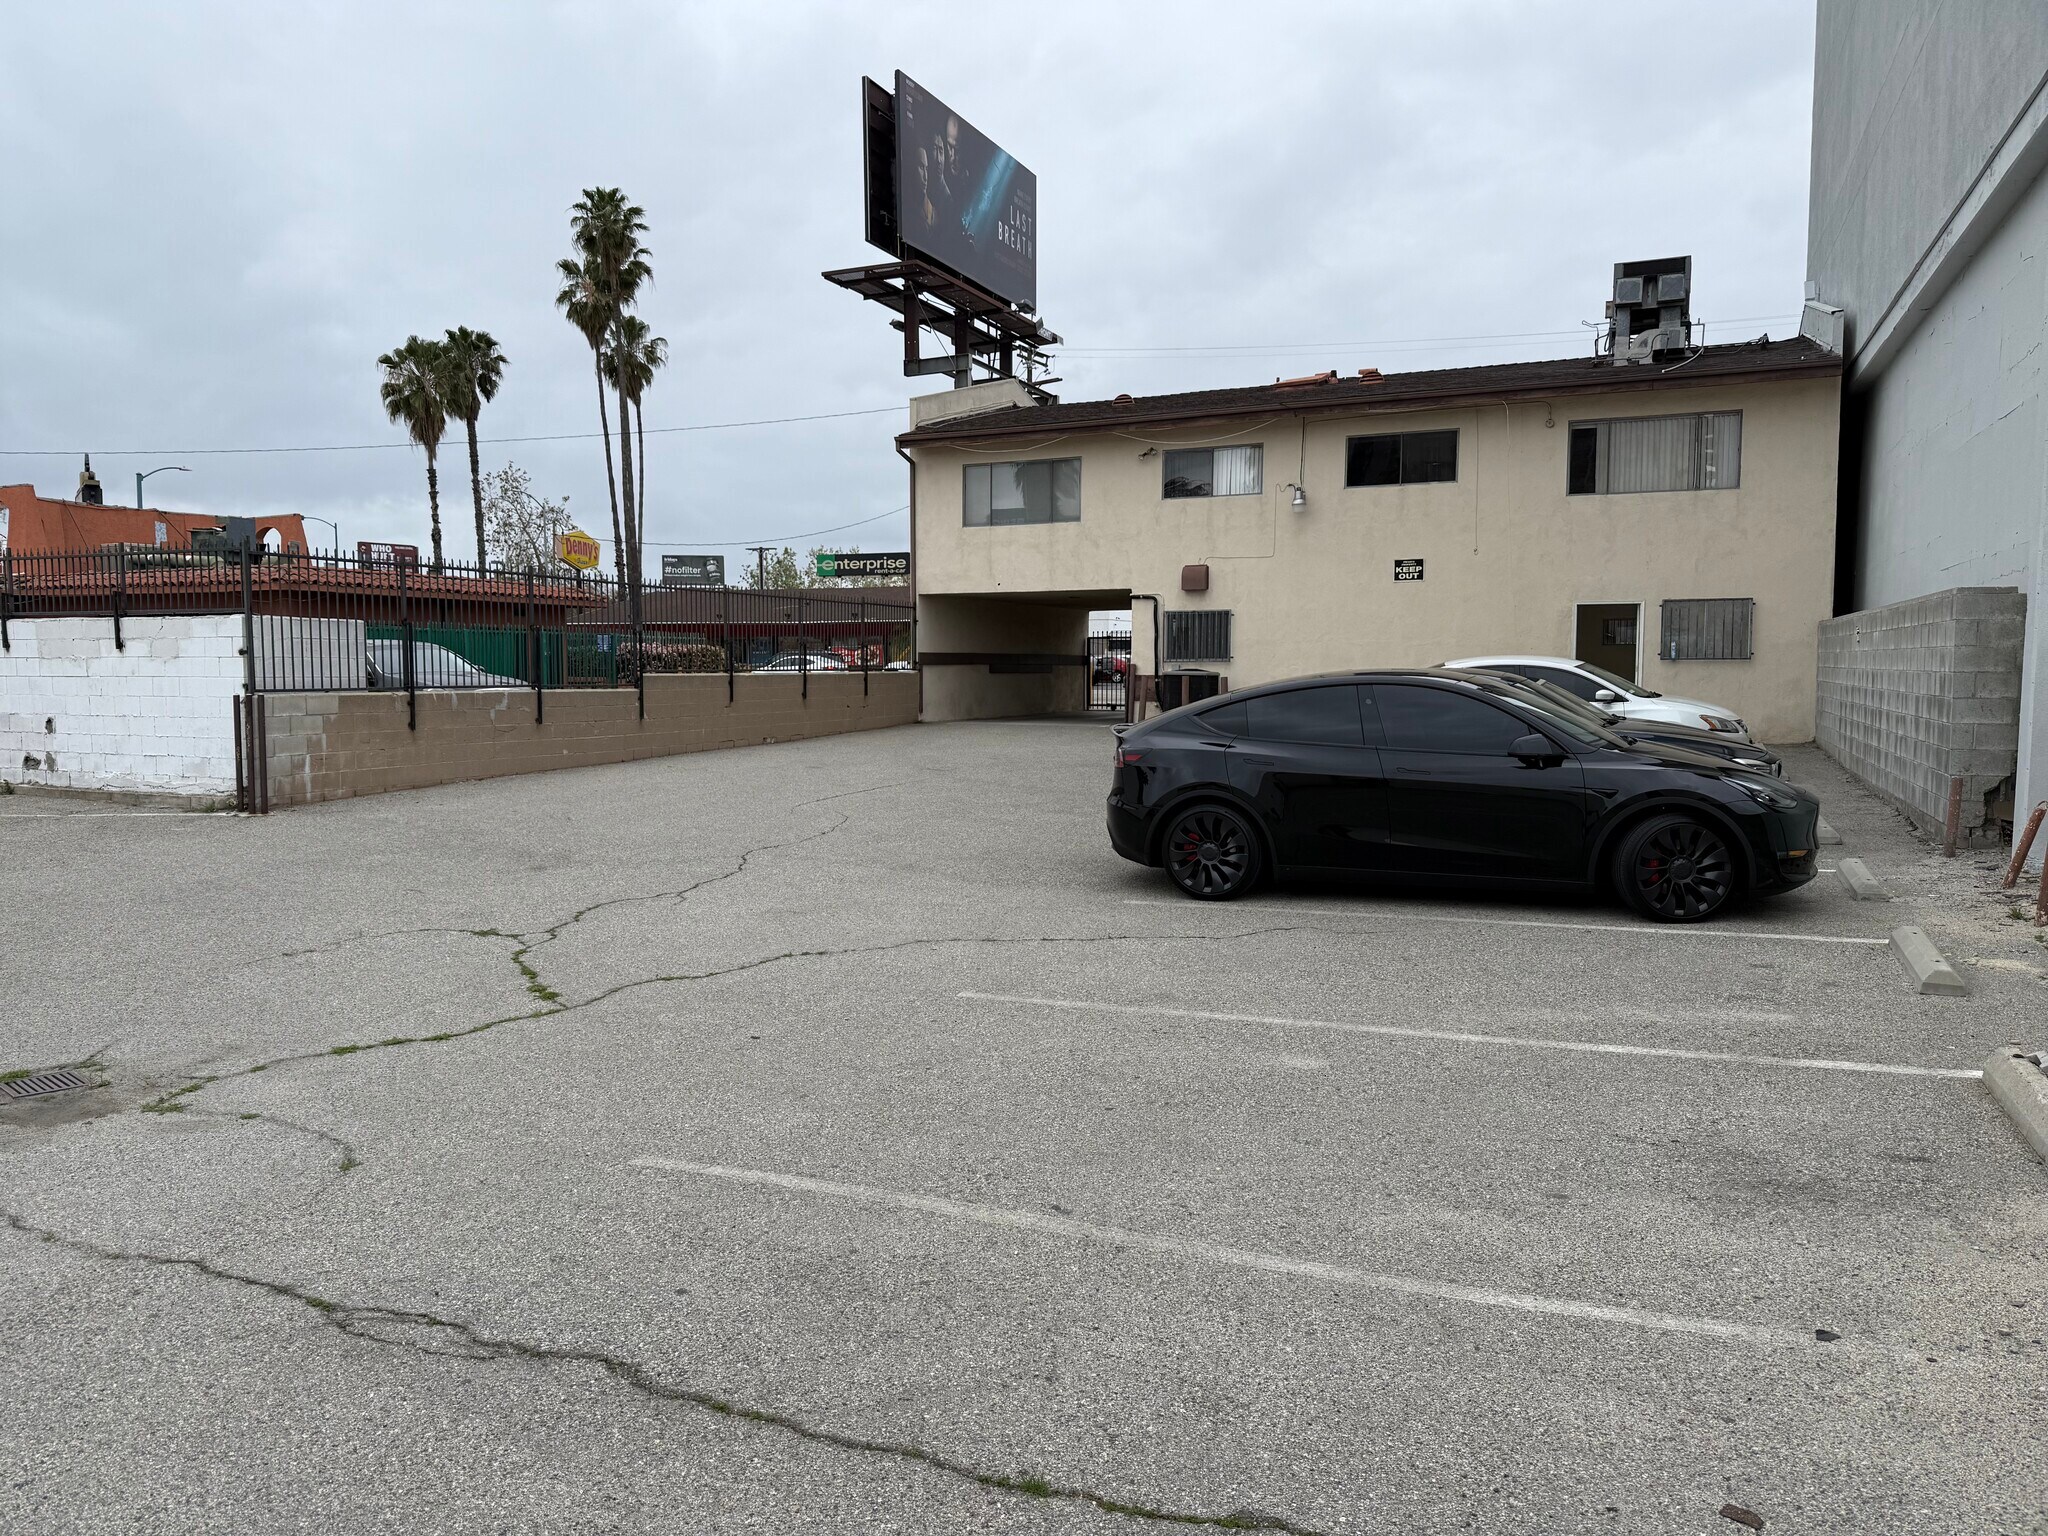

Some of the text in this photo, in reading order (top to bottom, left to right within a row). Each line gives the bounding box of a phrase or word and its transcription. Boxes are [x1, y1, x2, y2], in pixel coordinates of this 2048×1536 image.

[1010, 205, 1032, 236] LAST
[998, 220, 1032, 260] BREATH
[371, 544, 392, 552] WHO
[565, 537, 599, 561] Denny's
[664, 566, 701, 574] #nofilter
[822, 556, 906, 572] enterprise
